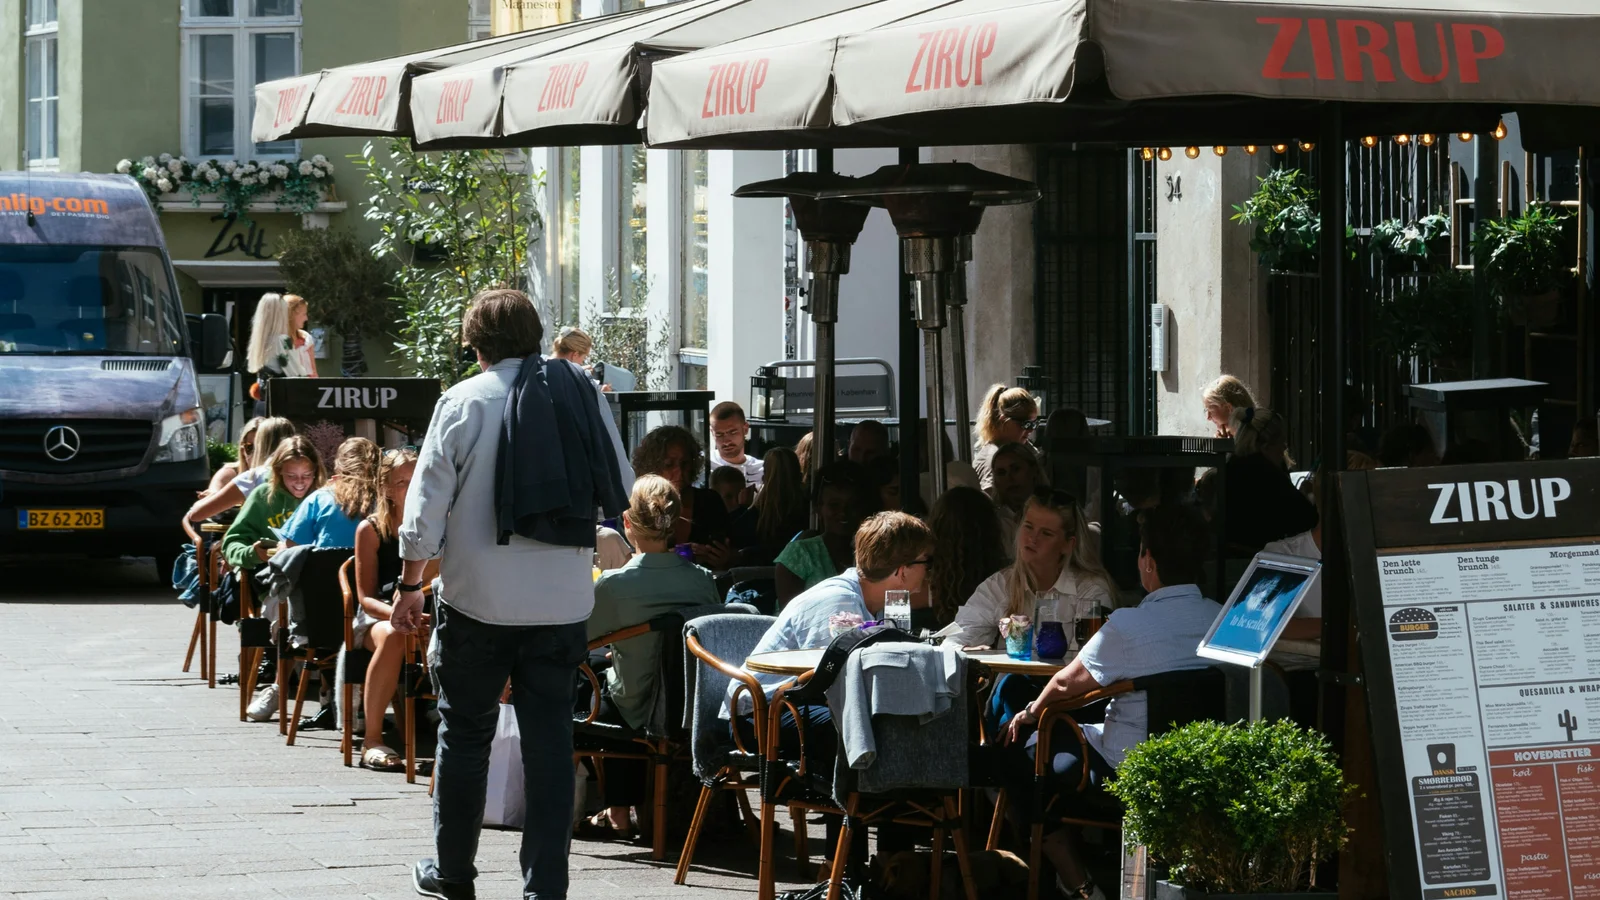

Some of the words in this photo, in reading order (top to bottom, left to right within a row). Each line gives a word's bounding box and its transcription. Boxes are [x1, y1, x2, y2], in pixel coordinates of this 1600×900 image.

[502, 0, 561, 10] Maanesten
[1255, 16, 1505, 84] ZIRUP
[904, 22, 998, 94] ZIRUP
[537, 61, 589, 112] ZIRUP
[701, 58, 770, 119] ZIRUP
[335, 76, 388, 116] ZIRUP
[436, 78, 474, 125] ZIRUP
[203, 211, 273, 260] Zalt
[317, 386, 398, 409] ZIRUP
[1427, 477, 1571, 524] ZIRUP
[29, 512, 49, 526] BZ
[52, 512, 71, 526] 62
[74, 512, 102, 526] 203
[1457, 556, 1474, 564] Den
[1475, 555, 1500, 564] tunge
[1549, 549, 1600, 559] Morgenmad
[1383, 560, 1399, 568] Den
[1401, 559, 1421, 567] lette
[1458, 563, 1489, 571] brunch
[1383, 567, 1414, 575] brunch
[1503, 602, 1536, 612] SALATER
[1540, 602, 1547, 610] &
[1550, 599, 1600, 609] SANDWICHES
[1229, 614, 1238, 626] to
[1238, 614, 1246, 627] be
[1399, 623, 1430, 632] BURGER
[1519, 686, 1565, 698] QUESADILLA
[1568, 686, 1575, 694] &
[1513, 747, 1592, 761] HOVEDRETTER
[1512, 768, 1533, 777] kød
[1576, 764, 1596, 775] fisk
[1418, 775, 1472, 785] SMØRREBRØD
[1520, 852, 1550, 864] pasta
[1443, 888, 1477, 897] NACHOS
